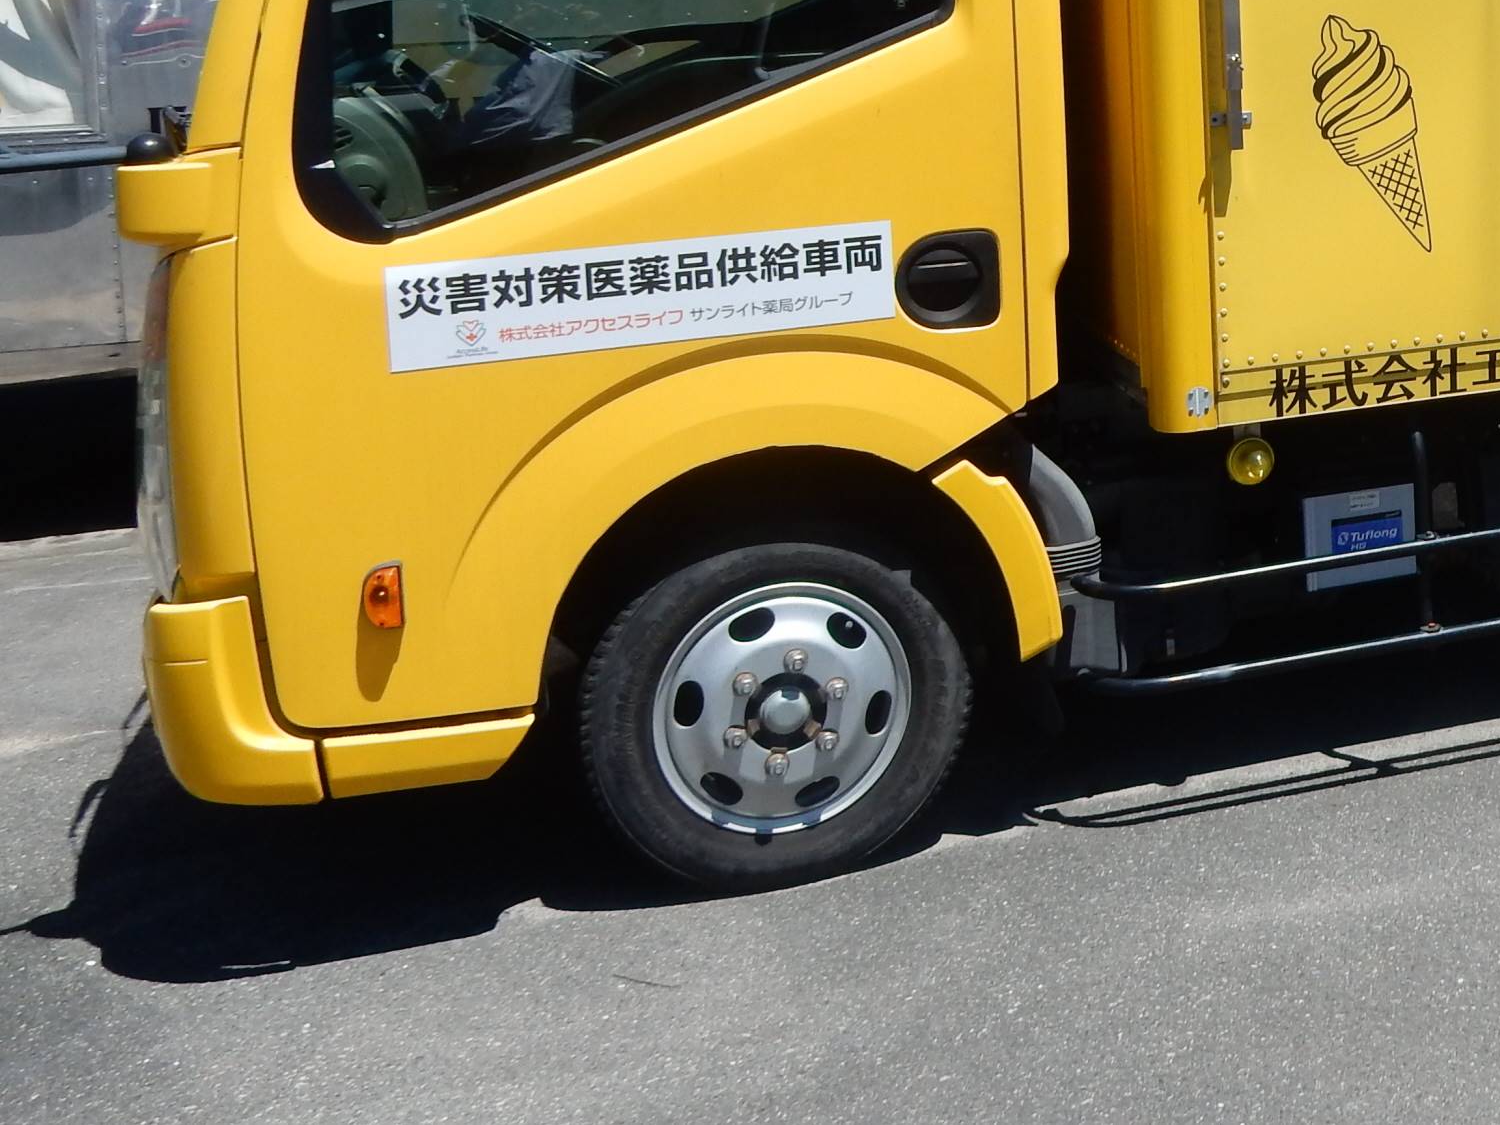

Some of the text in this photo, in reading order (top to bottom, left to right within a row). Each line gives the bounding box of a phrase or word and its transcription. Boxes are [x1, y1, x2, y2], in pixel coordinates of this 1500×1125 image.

[398, 234, 883, 320] 災害対策医薬品供給車両
[499, 291, 854, 343] 株式会社アクセスライフ サンライト薬局グループ
[1350, 527, 1398, 542] Tuflong
